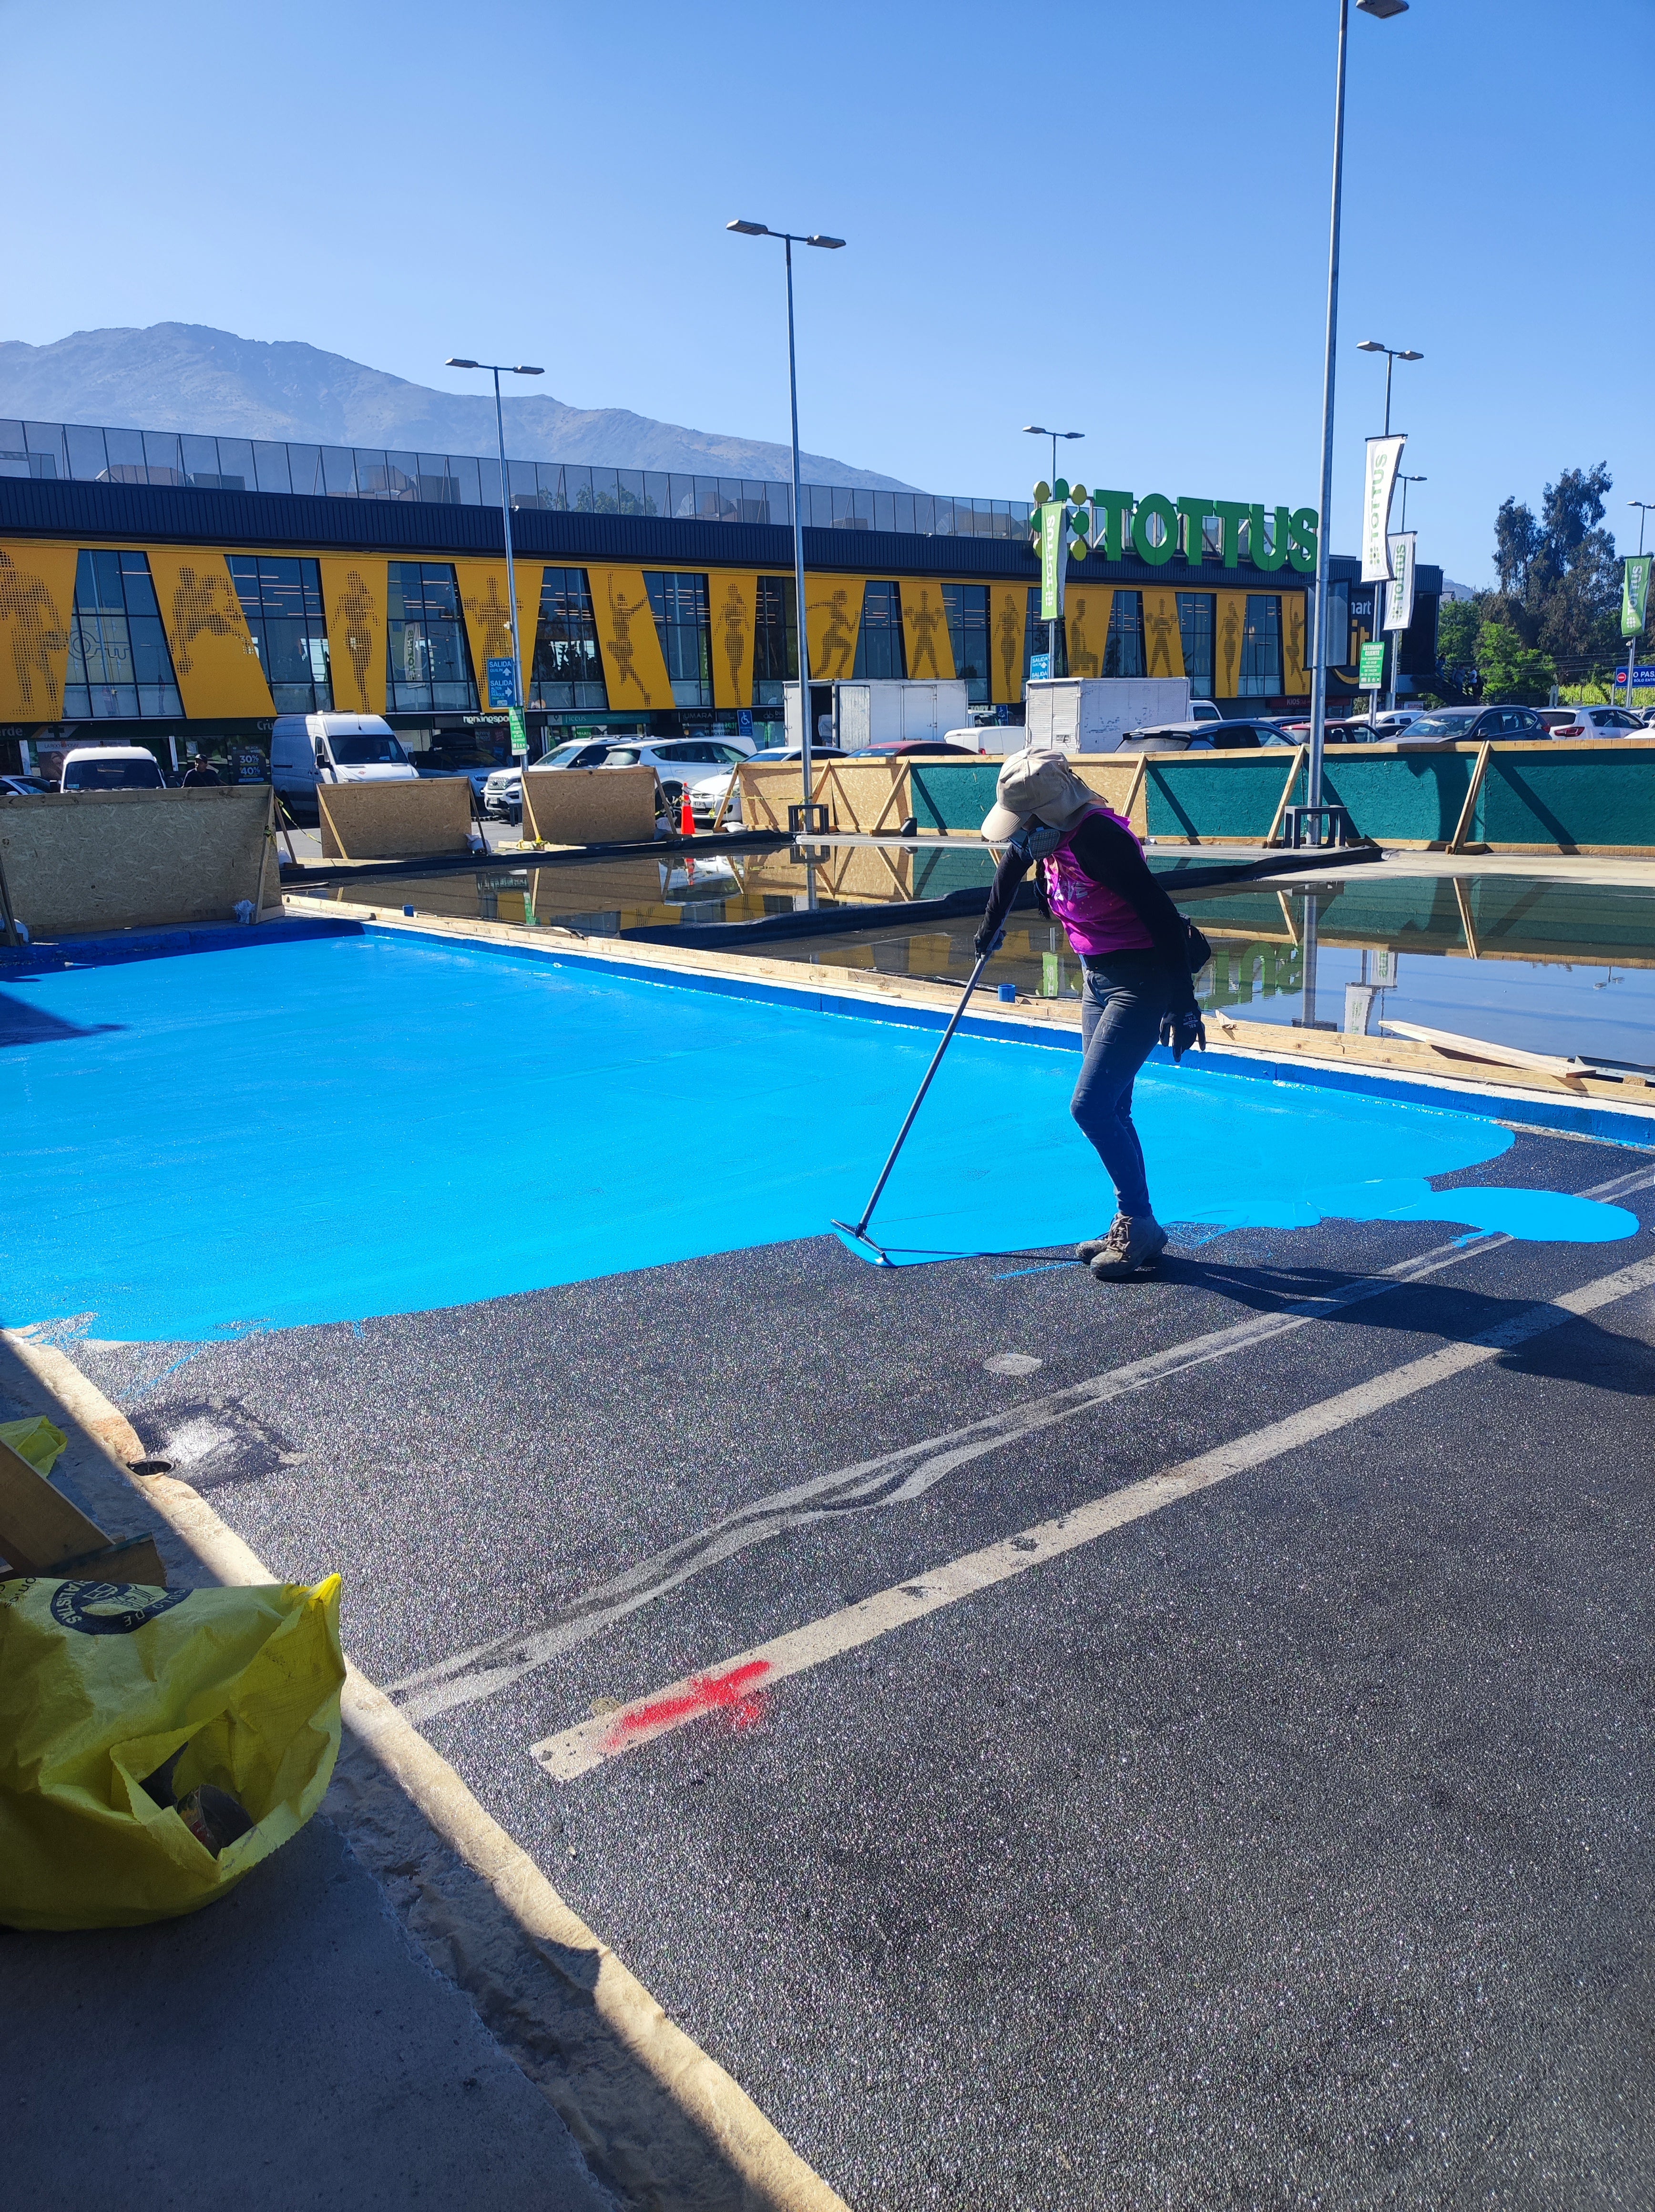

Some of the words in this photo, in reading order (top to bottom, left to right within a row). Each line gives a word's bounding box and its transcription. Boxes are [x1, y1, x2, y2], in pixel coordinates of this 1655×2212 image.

[1369, 453, 1388, 543] TOTTUS
[1093, 489, 1319, 573] TOTTUS
[1393, 543, 1406, 604] TOTTUS
[1627, 565, 1643, 615] TOTTUS
[257, 721, 274, 730] Cru
[239, 755, 259, 764] 30%
[240, 767, 261, 775] 40%
[124, 1609, 145, 1627] DE
